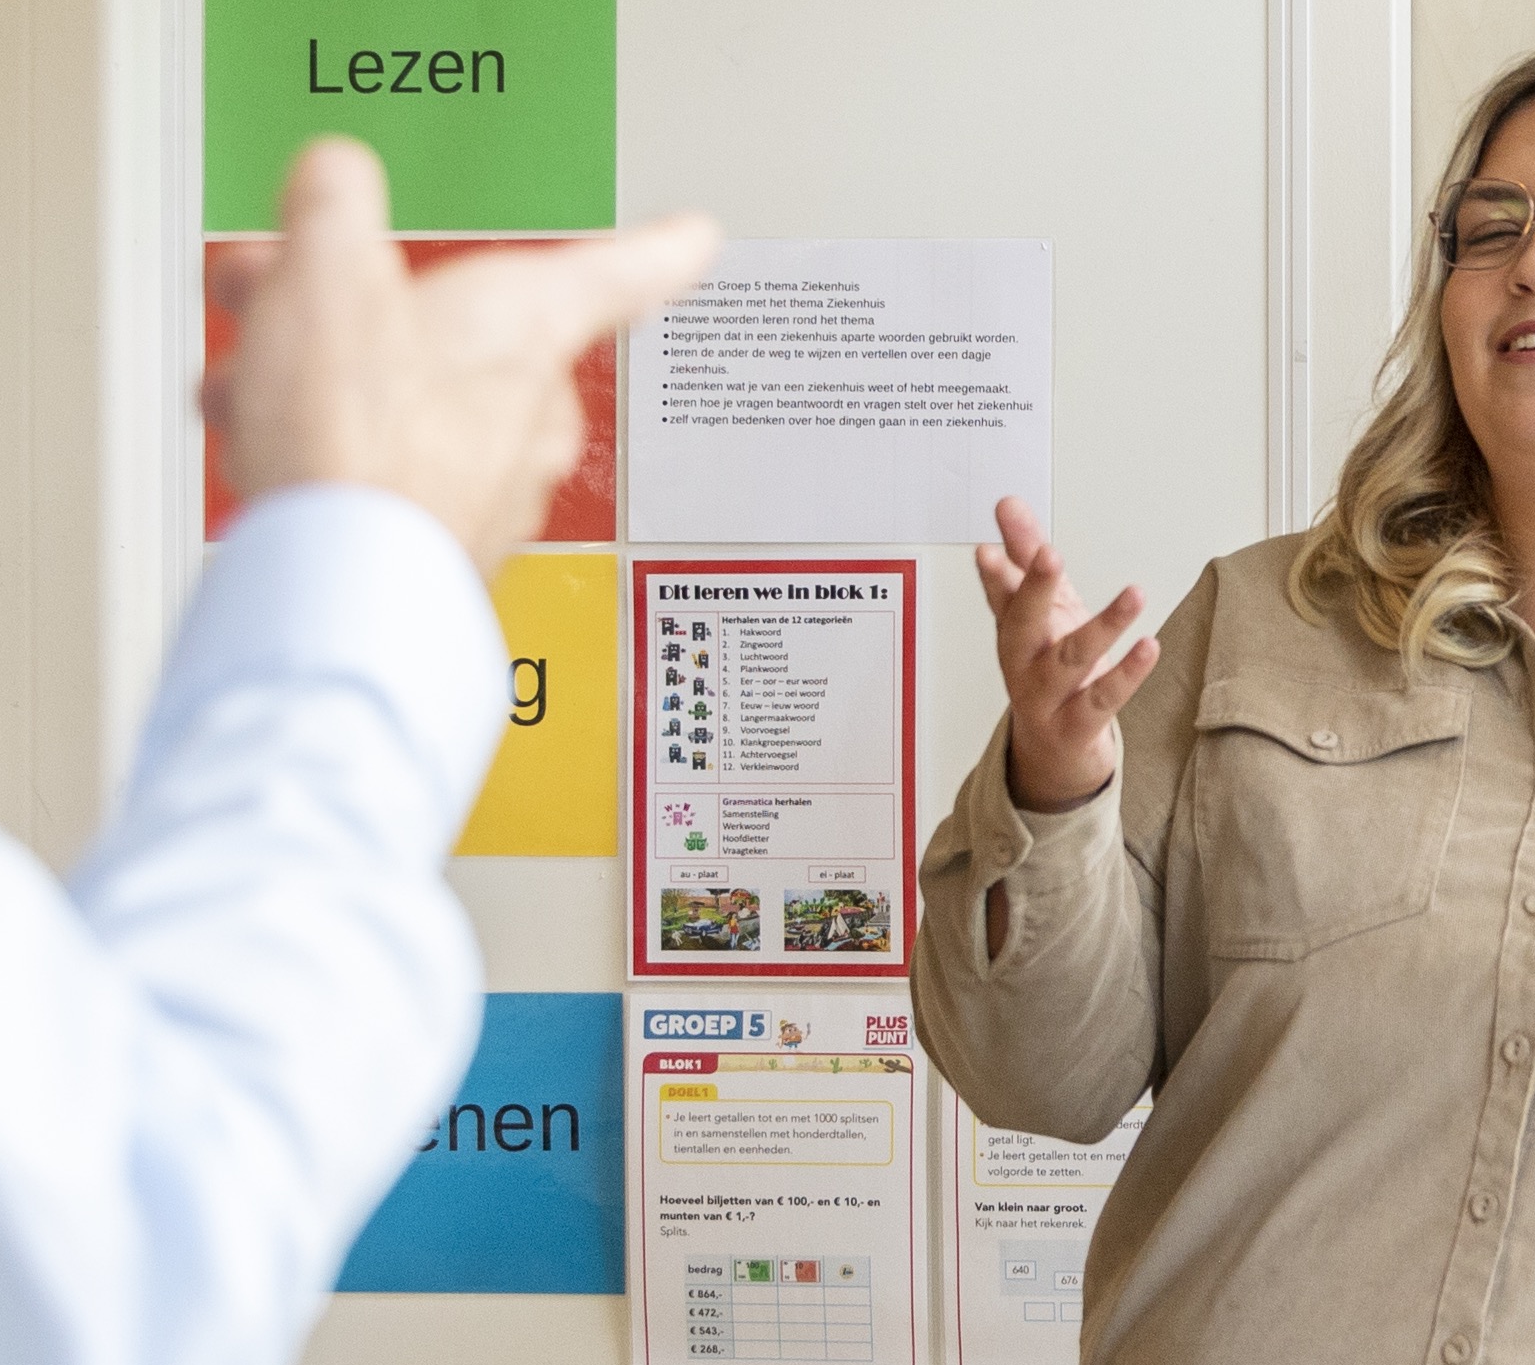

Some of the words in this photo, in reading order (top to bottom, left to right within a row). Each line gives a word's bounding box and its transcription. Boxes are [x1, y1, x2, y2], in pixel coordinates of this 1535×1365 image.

[308, 39, 504, 93] Lezen
[717, 280, 751, 292] Groep
[753, 280, 761, 291] 5
[763, 281, 798, 291] thema
[800, 280, 860, 292] Ziekenhuis
[672, 297, 743, 307] kennismaken
[745, 298, 767, 308] met
[769, 297, 787, 308] het
[789, 297, 824, 308] thema
[826, 297, 886, 309] Ziekenhuis
[671, 315, 710, 324] nieuwe
[712, 314, 759, 324] woorden
[761, 314, 790, 325] leren
[792, 315, 817, 325] rond
[819, 314, 837, 325] het
[839, 315, 875, 325] thema
[670, 330, 721, 343] begrijpen
[723, 330, 741, 341] dat
[743, 332, 754, 341] in
[755, 332, 777, 341] een
[780, 331, 837, 342] ziekenhuis
[839, 333, 875, 344] aparte
[877, 332, 925, 342] woorden
[927, 332, 972, 345] gebruikt
[974, 333, 1018, 343] worden.
[669, 413, 689, 424] zelf
[691, 416, 729, 427] vragen
[731, 415, 785, 425] bedenken
[787, 416, 812, 426] over
[814, 415, 836, 426] hoe
[838, 415, 875, 429] dingen
[878, 417, 906, 429] gaan
[908, 418, 919, 426] in
[921, 418, 943, 427] een
[945, 417, 1006, 427] ziekenhuis.
[721, 616, 760, 624] Herhalen
[778, 616, 789, 624] de
[792, 615, 802, 624] 12
[722, 797, 773, 806] Grammatica
[774, 797, 812, 806] herhalen
[722, 822, 770, 830] Werkwoord
[722, 847, 768, 857] Vraagteken
[649, 1014, 736, 1035] GROEP
[748, 1013, 765, 1037] 5
[866, 1015, 907, 1029] PLUS
[867, 1032, 907, 1045] PUNT
[659, 1195, 704, 1205] Hoeveel
[706, 1195, 752, 1207] biljetten
[754, 1198, 774, 1206] van
[816, 1198, 830, 1206] en
[866, 1199, 880, 1207] en
[974, 1202, 995, 1212] Van
[997, 1201, 1024, 1212] klein
[1026, 1204, 1050, 1212] naar
[1053, 1203, 1088, 1215] groot.
[659, 1212, 700, 1220] munten
[702, 1213, 722, 1221] van
[974, 1217, 992, 1230] Kijk
[995, 1220, 1017, 1228] naar
[1019, 1217, 1037, 1228] het
[1039, 1218, 1086, 1228] rekenrek.
[687, 1264, 723, 1277] bedrag
